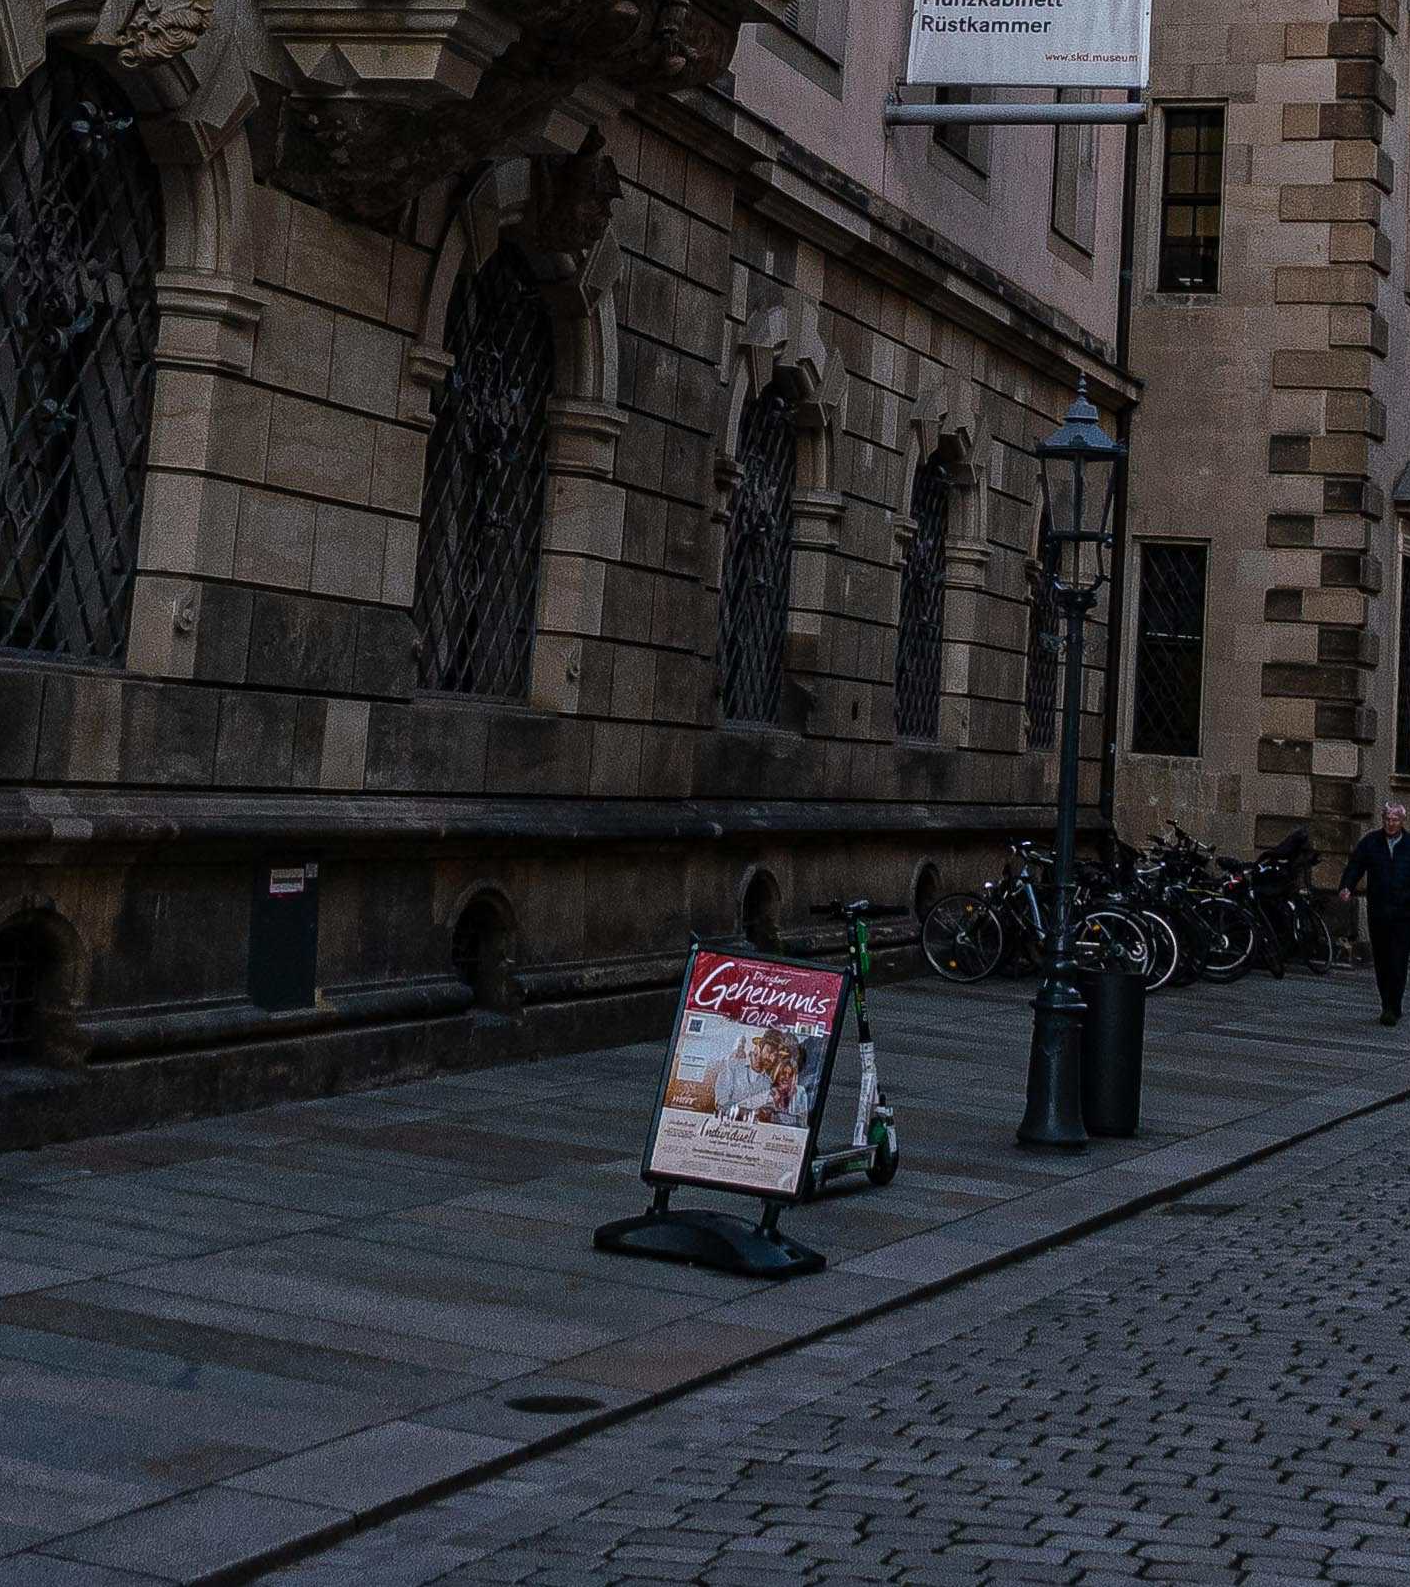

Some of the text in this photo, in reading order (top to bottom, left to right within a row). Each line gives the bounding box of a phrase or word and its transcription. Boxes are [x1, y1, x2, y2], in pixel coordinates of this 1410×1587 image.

[921, 14, 1052, 33] Rüstkammer
[1045, 52, 1138, 63] www.skd.museum
[695, 962, 831, 1014] Geheimnis
[739, 1006, 780, 1029] TOUR
